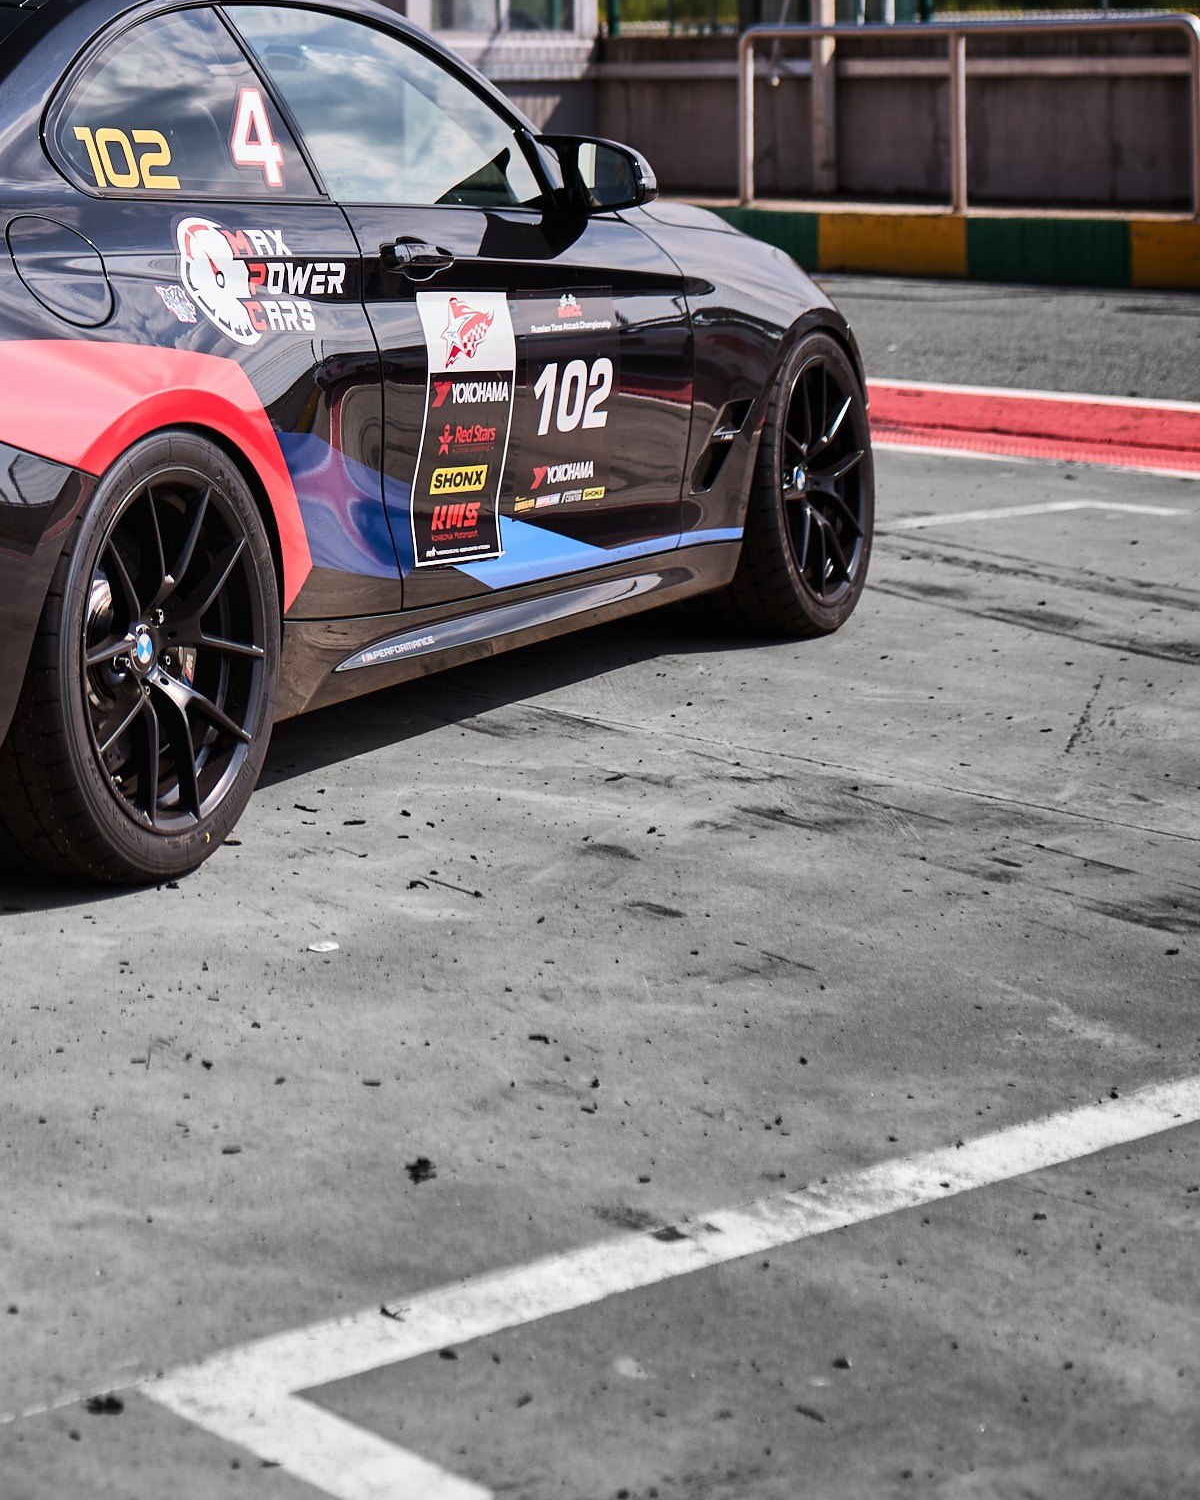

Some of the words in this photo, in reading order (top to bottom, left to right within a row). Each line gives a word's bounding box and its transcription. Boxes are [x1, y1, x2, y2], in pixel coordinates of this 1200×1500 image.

[232, 88, 284, 187] 4
[73, 126, 181, 190] 102
[220, 229, 293, 256] MAX
[248, 262, 346, 295] POWER
[242, 301, 316, 332] CARS
[452, 381, 509, 404] YOKOHAMA
[534, 357, 613, 436] 102
[455, 425, 474, 443] Red
[474, 424, 496, 442] Stars
[433, 470, 484, 490] SHONX
[546, 460, 594, 485] YOKOHAMA
[431, 502, 481, 531] KMS
[373, 635, 435, 659] PERFORMANCE
